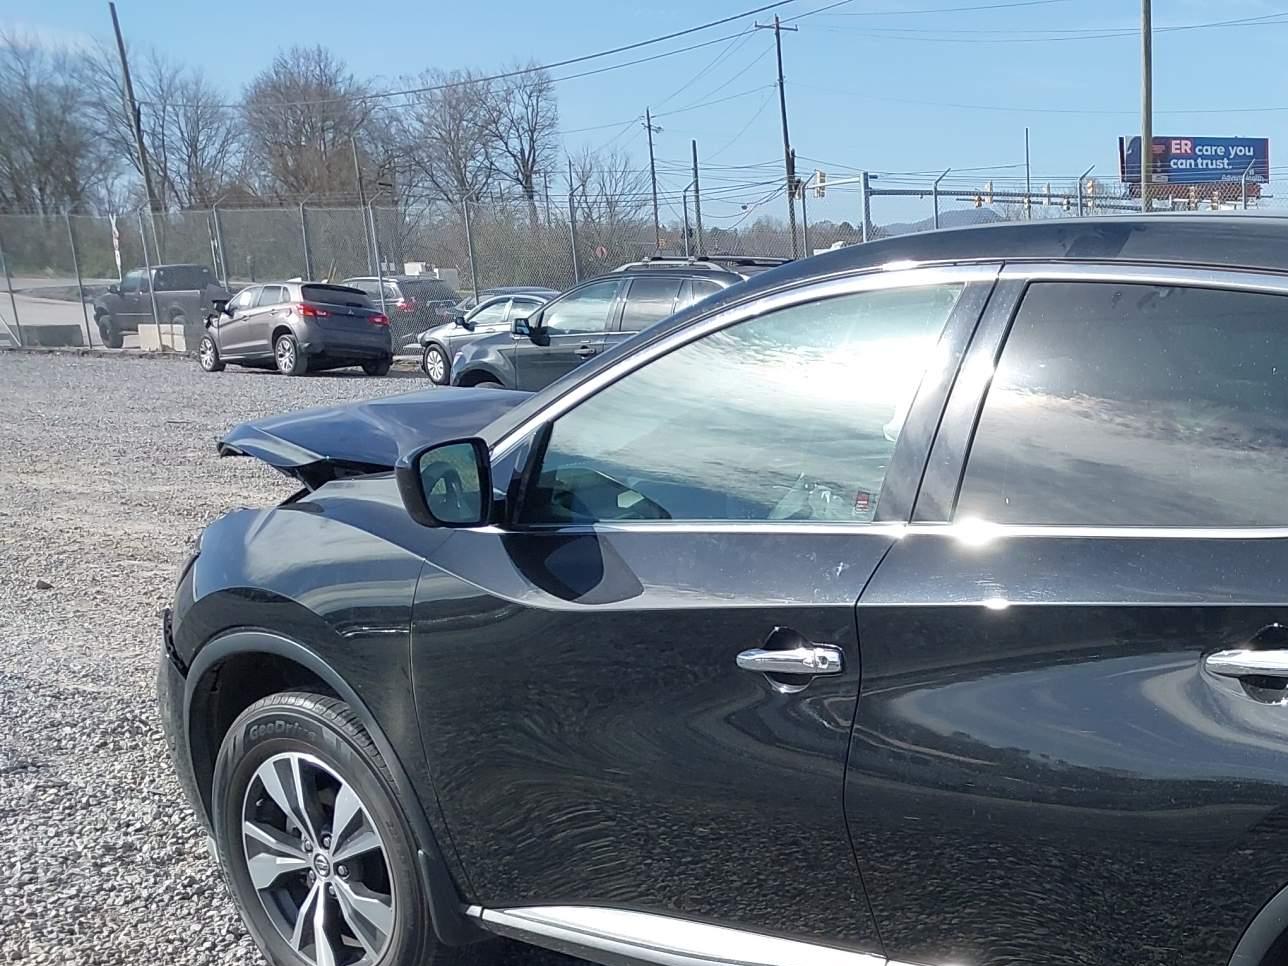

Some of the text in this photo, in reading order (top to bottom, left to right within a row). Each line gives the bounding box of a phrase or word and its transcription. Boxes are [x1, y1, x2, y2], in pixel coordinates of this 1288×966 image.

[1171, 140, 1192, 153] ER
[1195, 144, 1225, 155] care
[1228, 144, 1254, 158] you
[1170, 156, 1232, 168] can trust.
